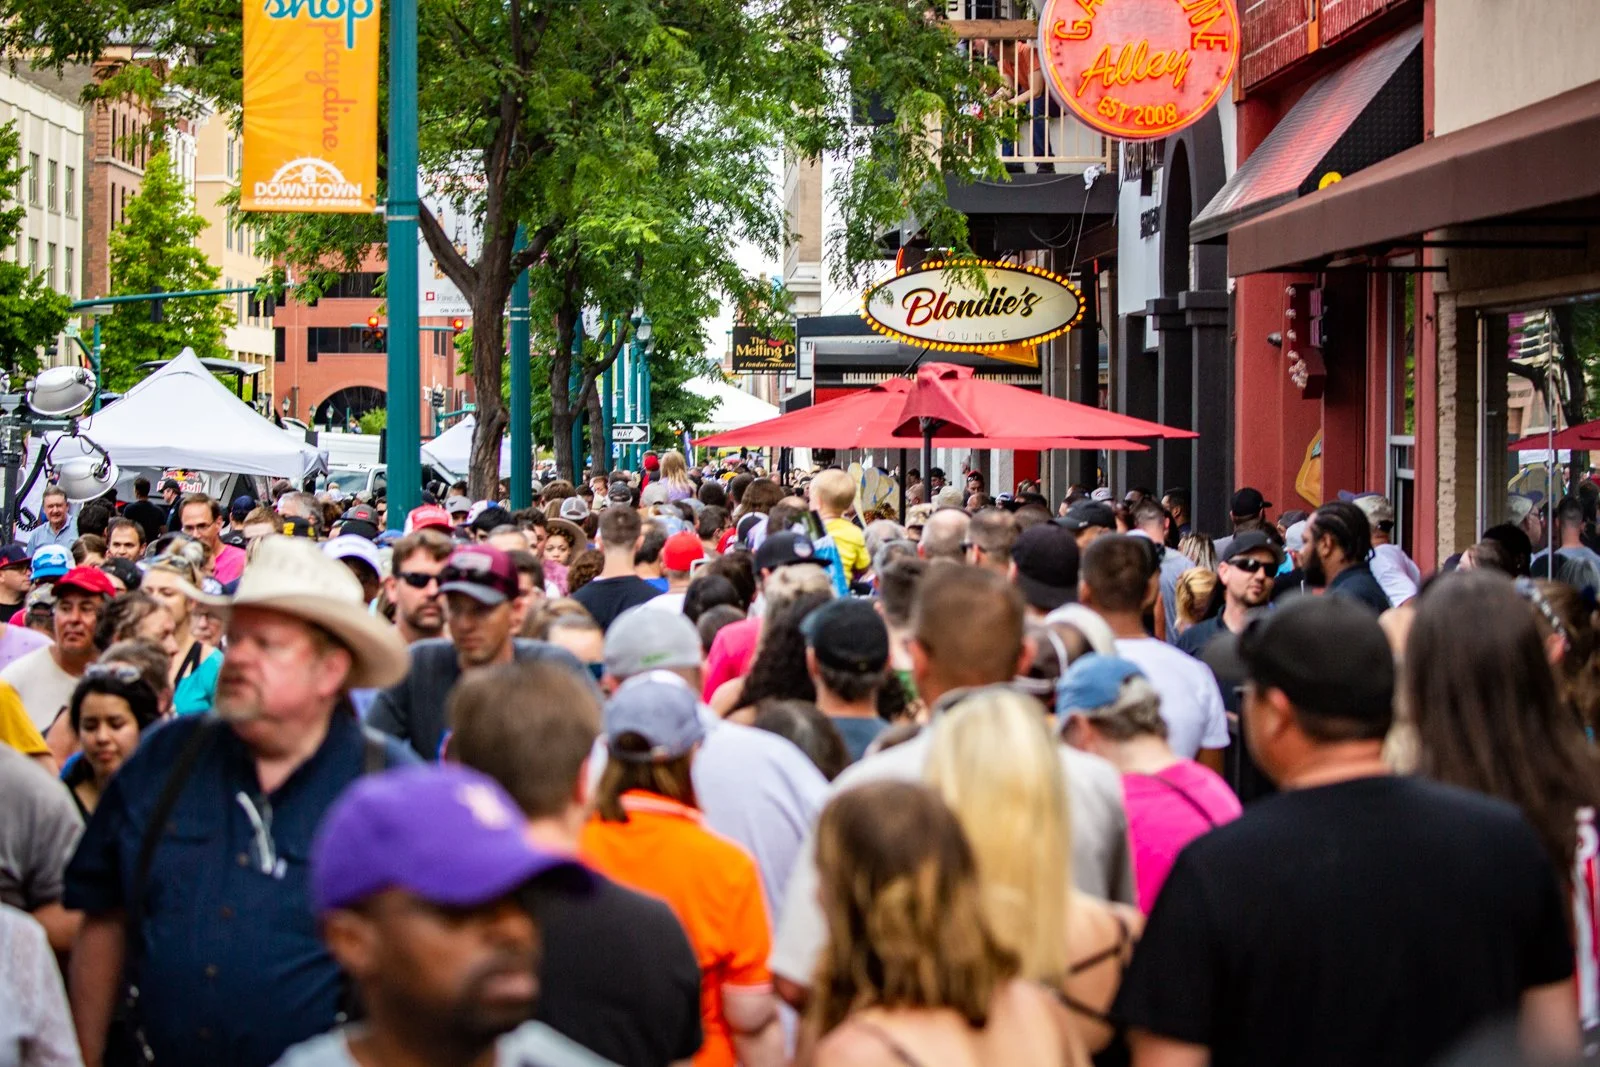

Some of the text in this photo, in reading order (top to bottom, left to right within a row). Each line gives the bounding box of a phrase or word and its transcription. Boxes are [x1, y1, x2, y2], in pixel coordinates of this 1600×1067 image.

[1077, 39, 1192, 98] Alley
[1097, 96, 1178, 126] EST 2008
[254, 182, 362, 197] DOWNTOWN
[254, 197, 362, 207] COLORADO SPRINGS
[902, 286, 1043, 327] Blondie's
[750, 336, 767, 345] The
[936, 329, 1009, 341] LOUNGE
[735, 344, 783, 359] Melting
